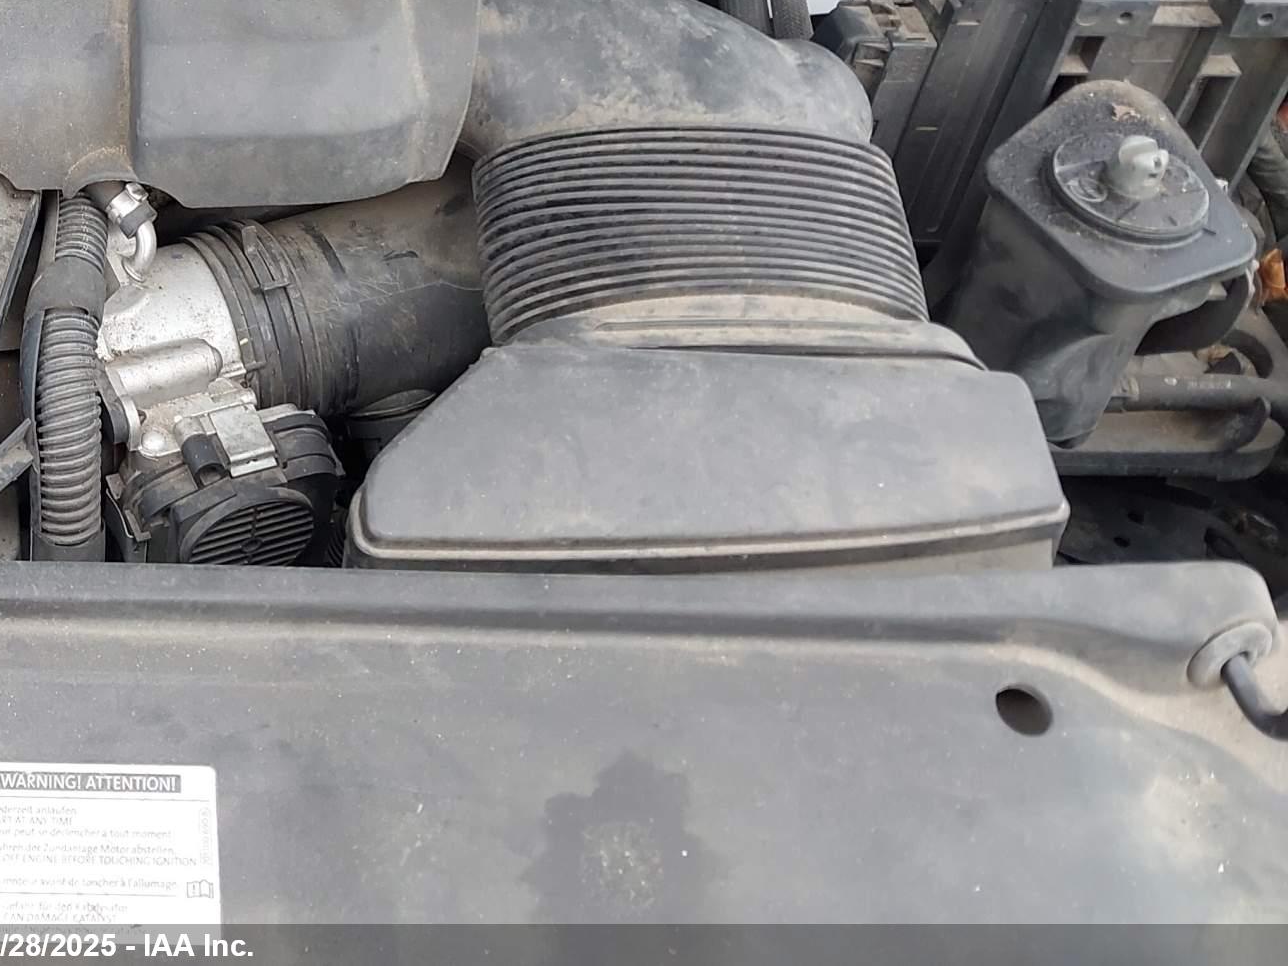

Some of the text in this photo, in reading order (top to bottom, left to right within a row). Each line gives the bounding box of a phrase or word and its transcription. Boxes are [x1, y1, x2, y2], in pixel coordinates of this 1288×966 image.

[0, 771, 81, 791] WARNING!
[86, 774, 177, 793] ATTENTION!
[15, 816, 26, 825] AT
[30, 817, 47, 826] ANY
[51, 817, 73, 826] TIME
[14, 827, 35, 838] peut
[109, 829, 129, 838] tout
[100, 845, 130, 855] Motor
[61, 855, 96, 865] BEFORE
[99, 855, 151, 866] TOUCHING
[152, 856, 197, 867] IGNITION
[26, 912, 69, 923] DAMAGE
